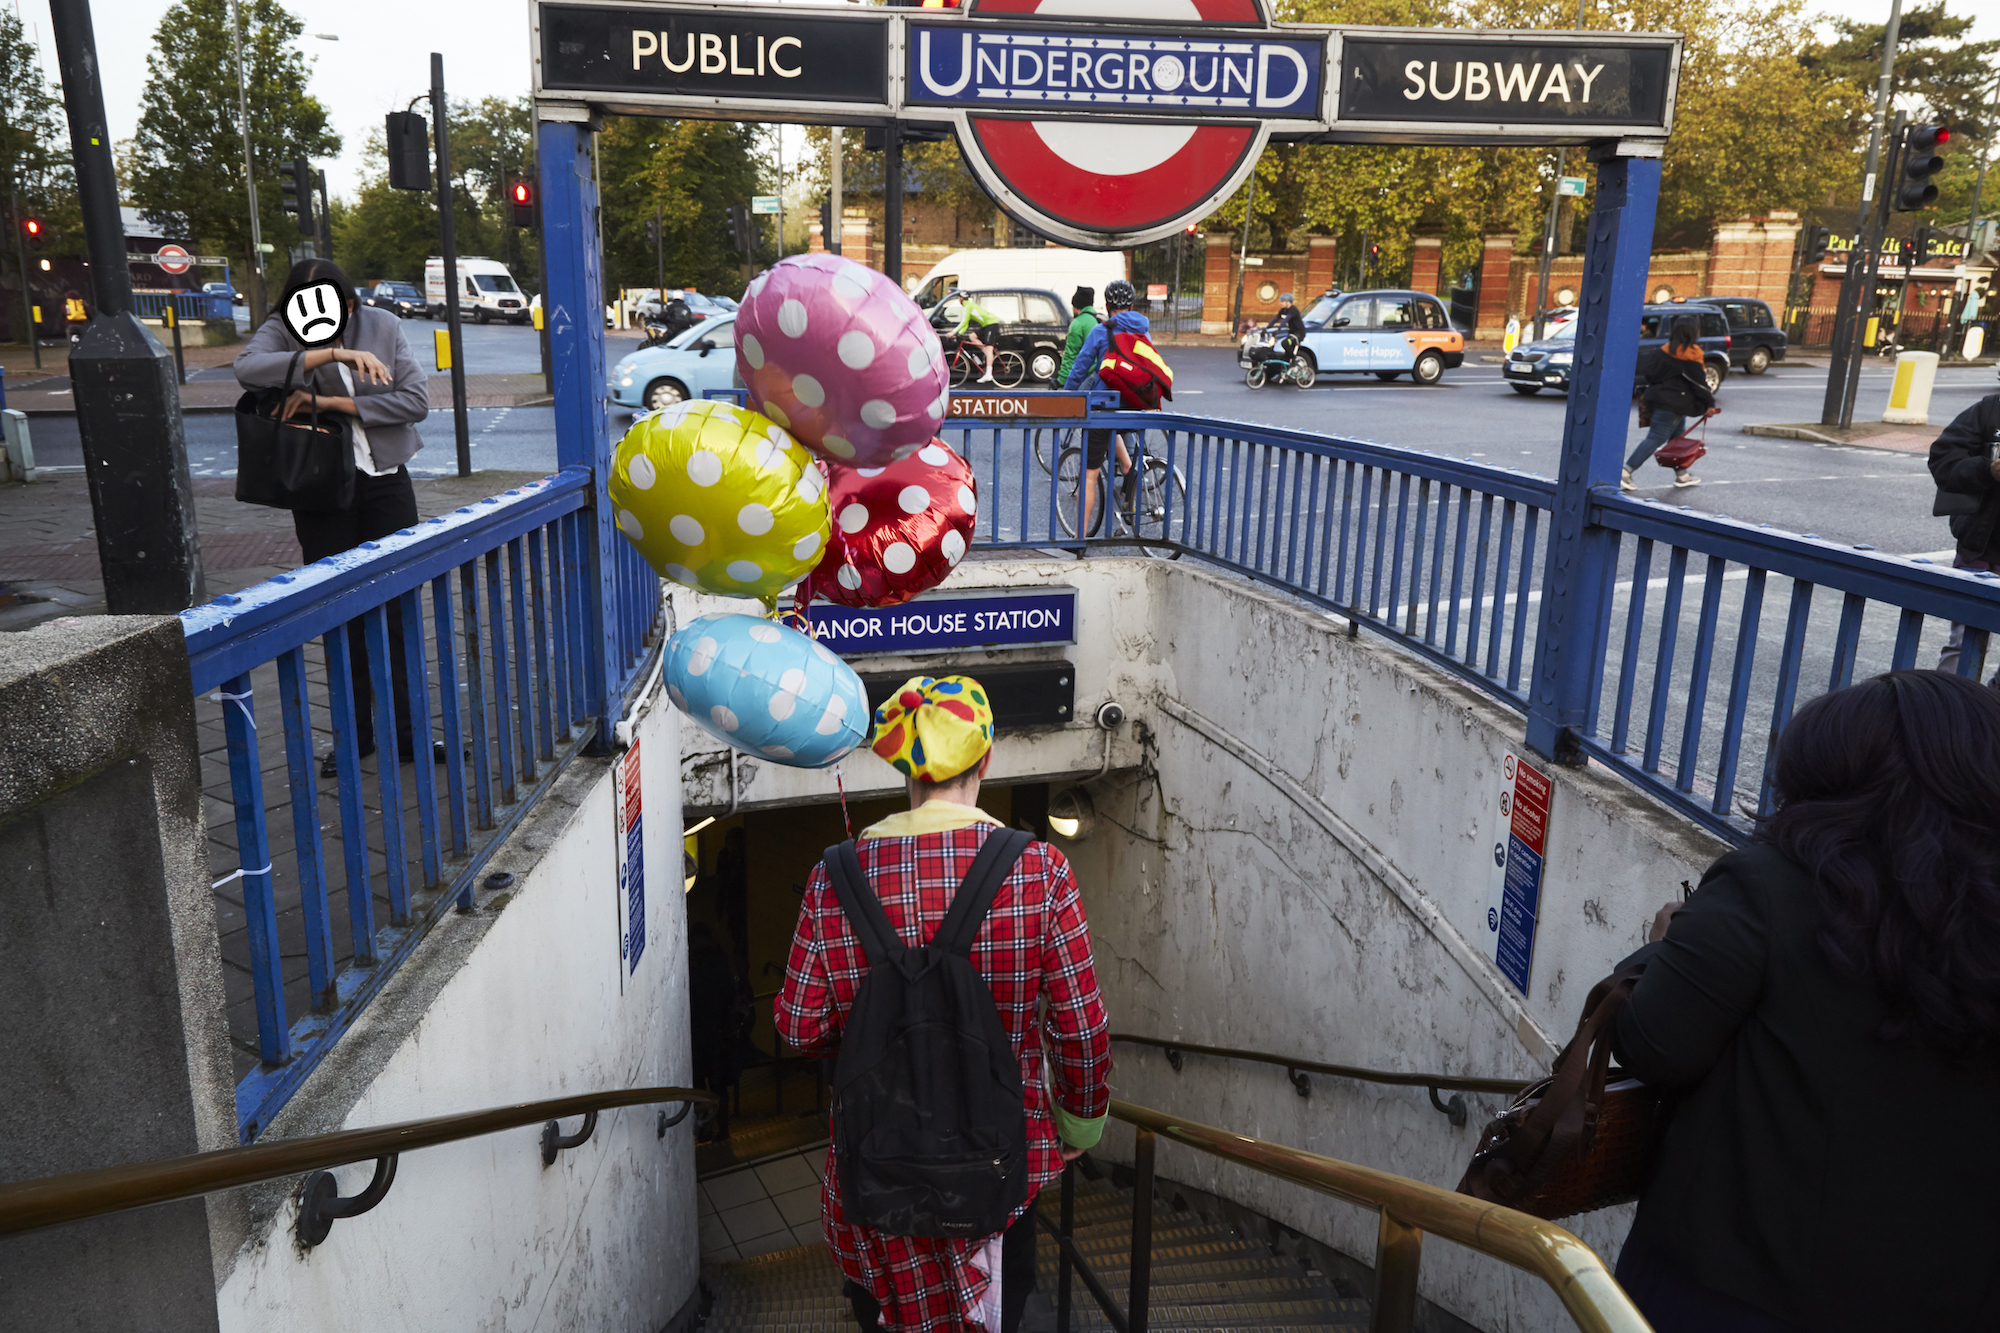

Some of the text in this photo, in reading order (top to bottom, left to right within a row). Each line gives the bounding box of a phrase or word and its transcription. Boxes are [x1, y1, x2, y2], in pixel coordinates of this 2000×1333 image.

[632, 30, 1605, 108] PUBLIC UNDERGROUND SUBWAY
[1343, 346, 1403, 358] Meet Happy.
[952, 399, 1028, 415] STATION
[891, 612, 967, 636] HOUSE
[973, 608, 1061, 631] STATION
[1518, 766, 1547, 796] No smoking
[1515, 797, 1540, 824] No alcohol
